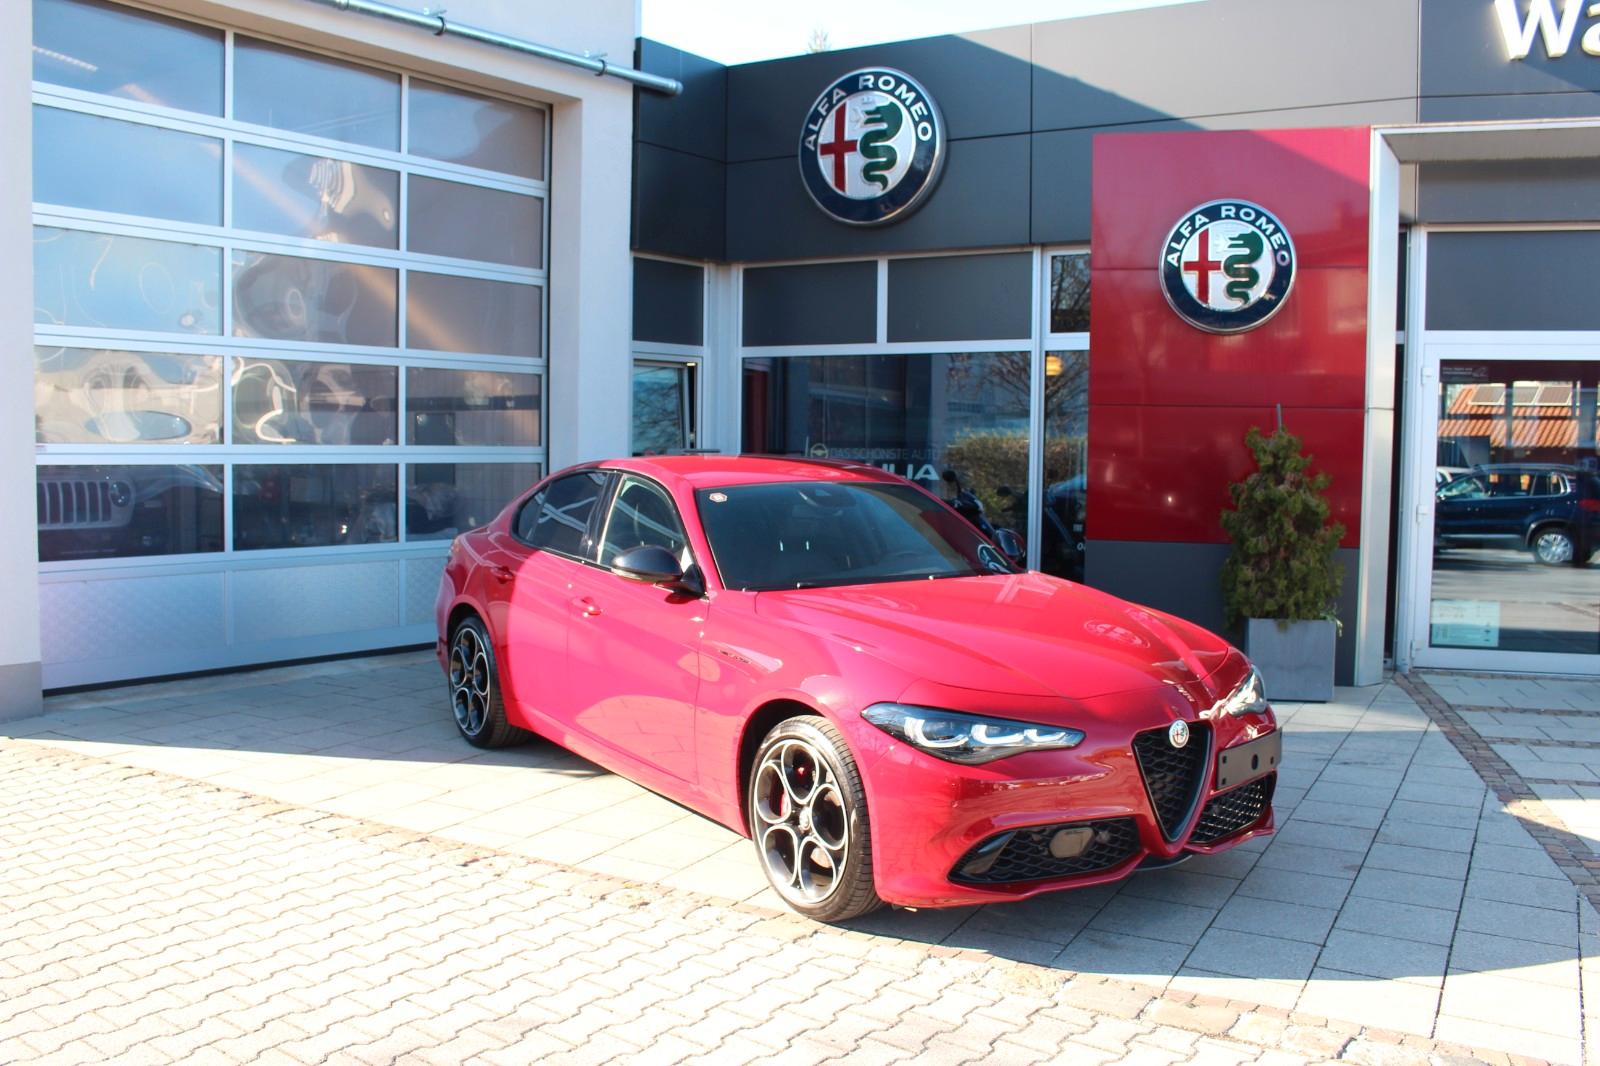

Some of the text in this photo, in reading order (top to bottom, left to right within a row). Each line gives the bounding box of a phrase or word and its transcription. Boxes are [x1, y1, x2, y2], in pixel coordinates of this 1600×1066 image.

[804, 74, 932, 151] ALFA ROMEO
[1167, 205, 1290, 268] ALFA ROMEO
